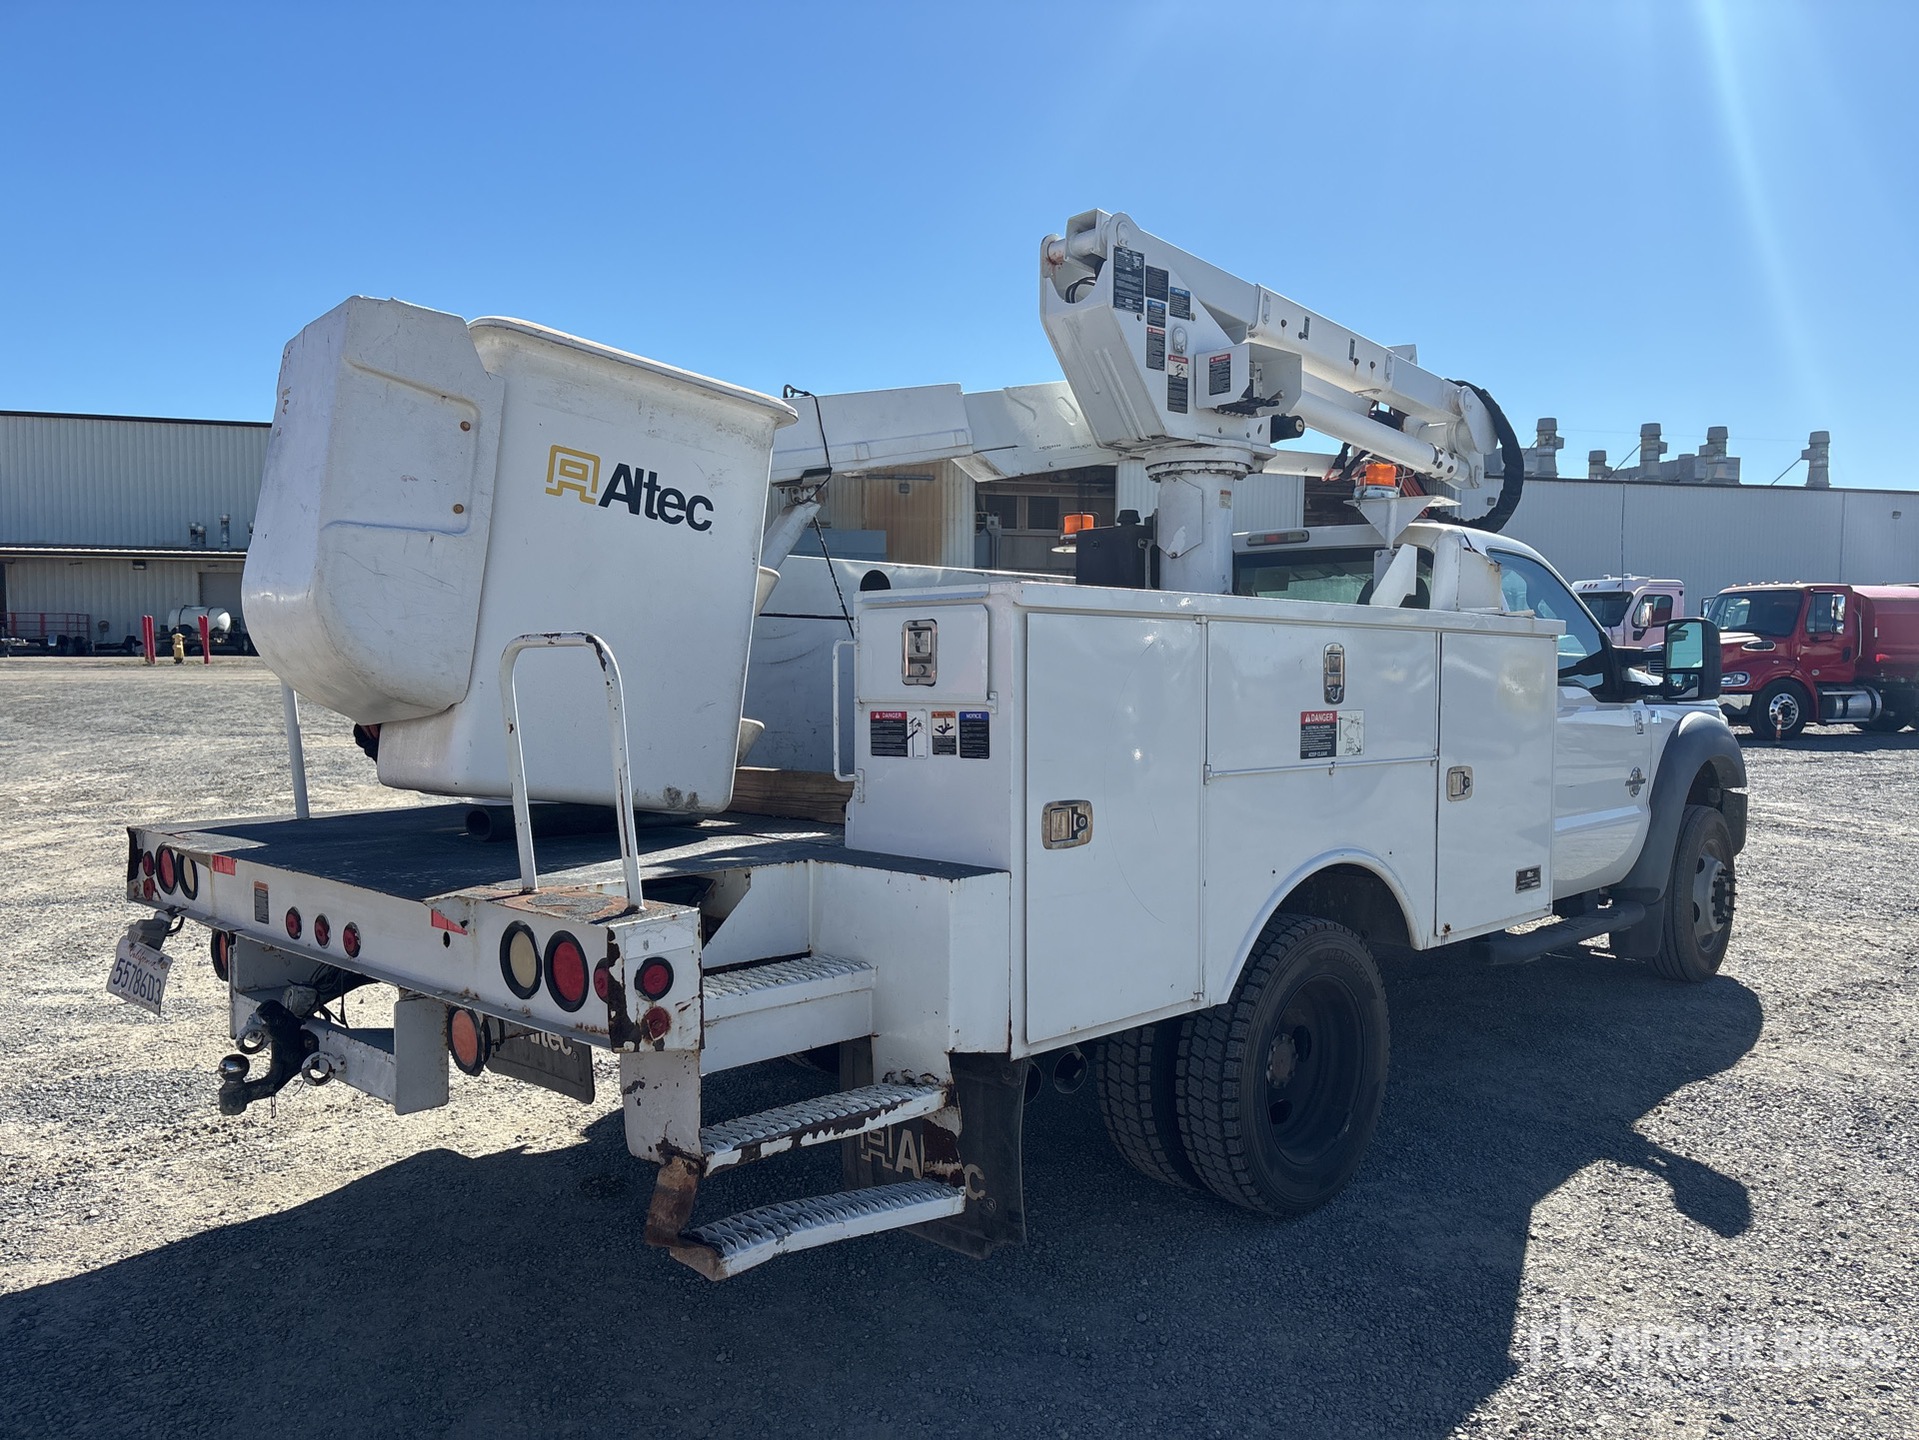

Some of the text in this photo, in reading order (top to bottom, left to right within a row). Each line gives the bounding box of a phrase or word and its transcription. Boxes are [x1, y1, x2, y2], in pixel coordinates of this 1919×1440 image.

[598, 462, 714, 532] Altec
[1310, 713, 1334, 722] DANGER
[112, 957, 162, 1006] 55786D3
